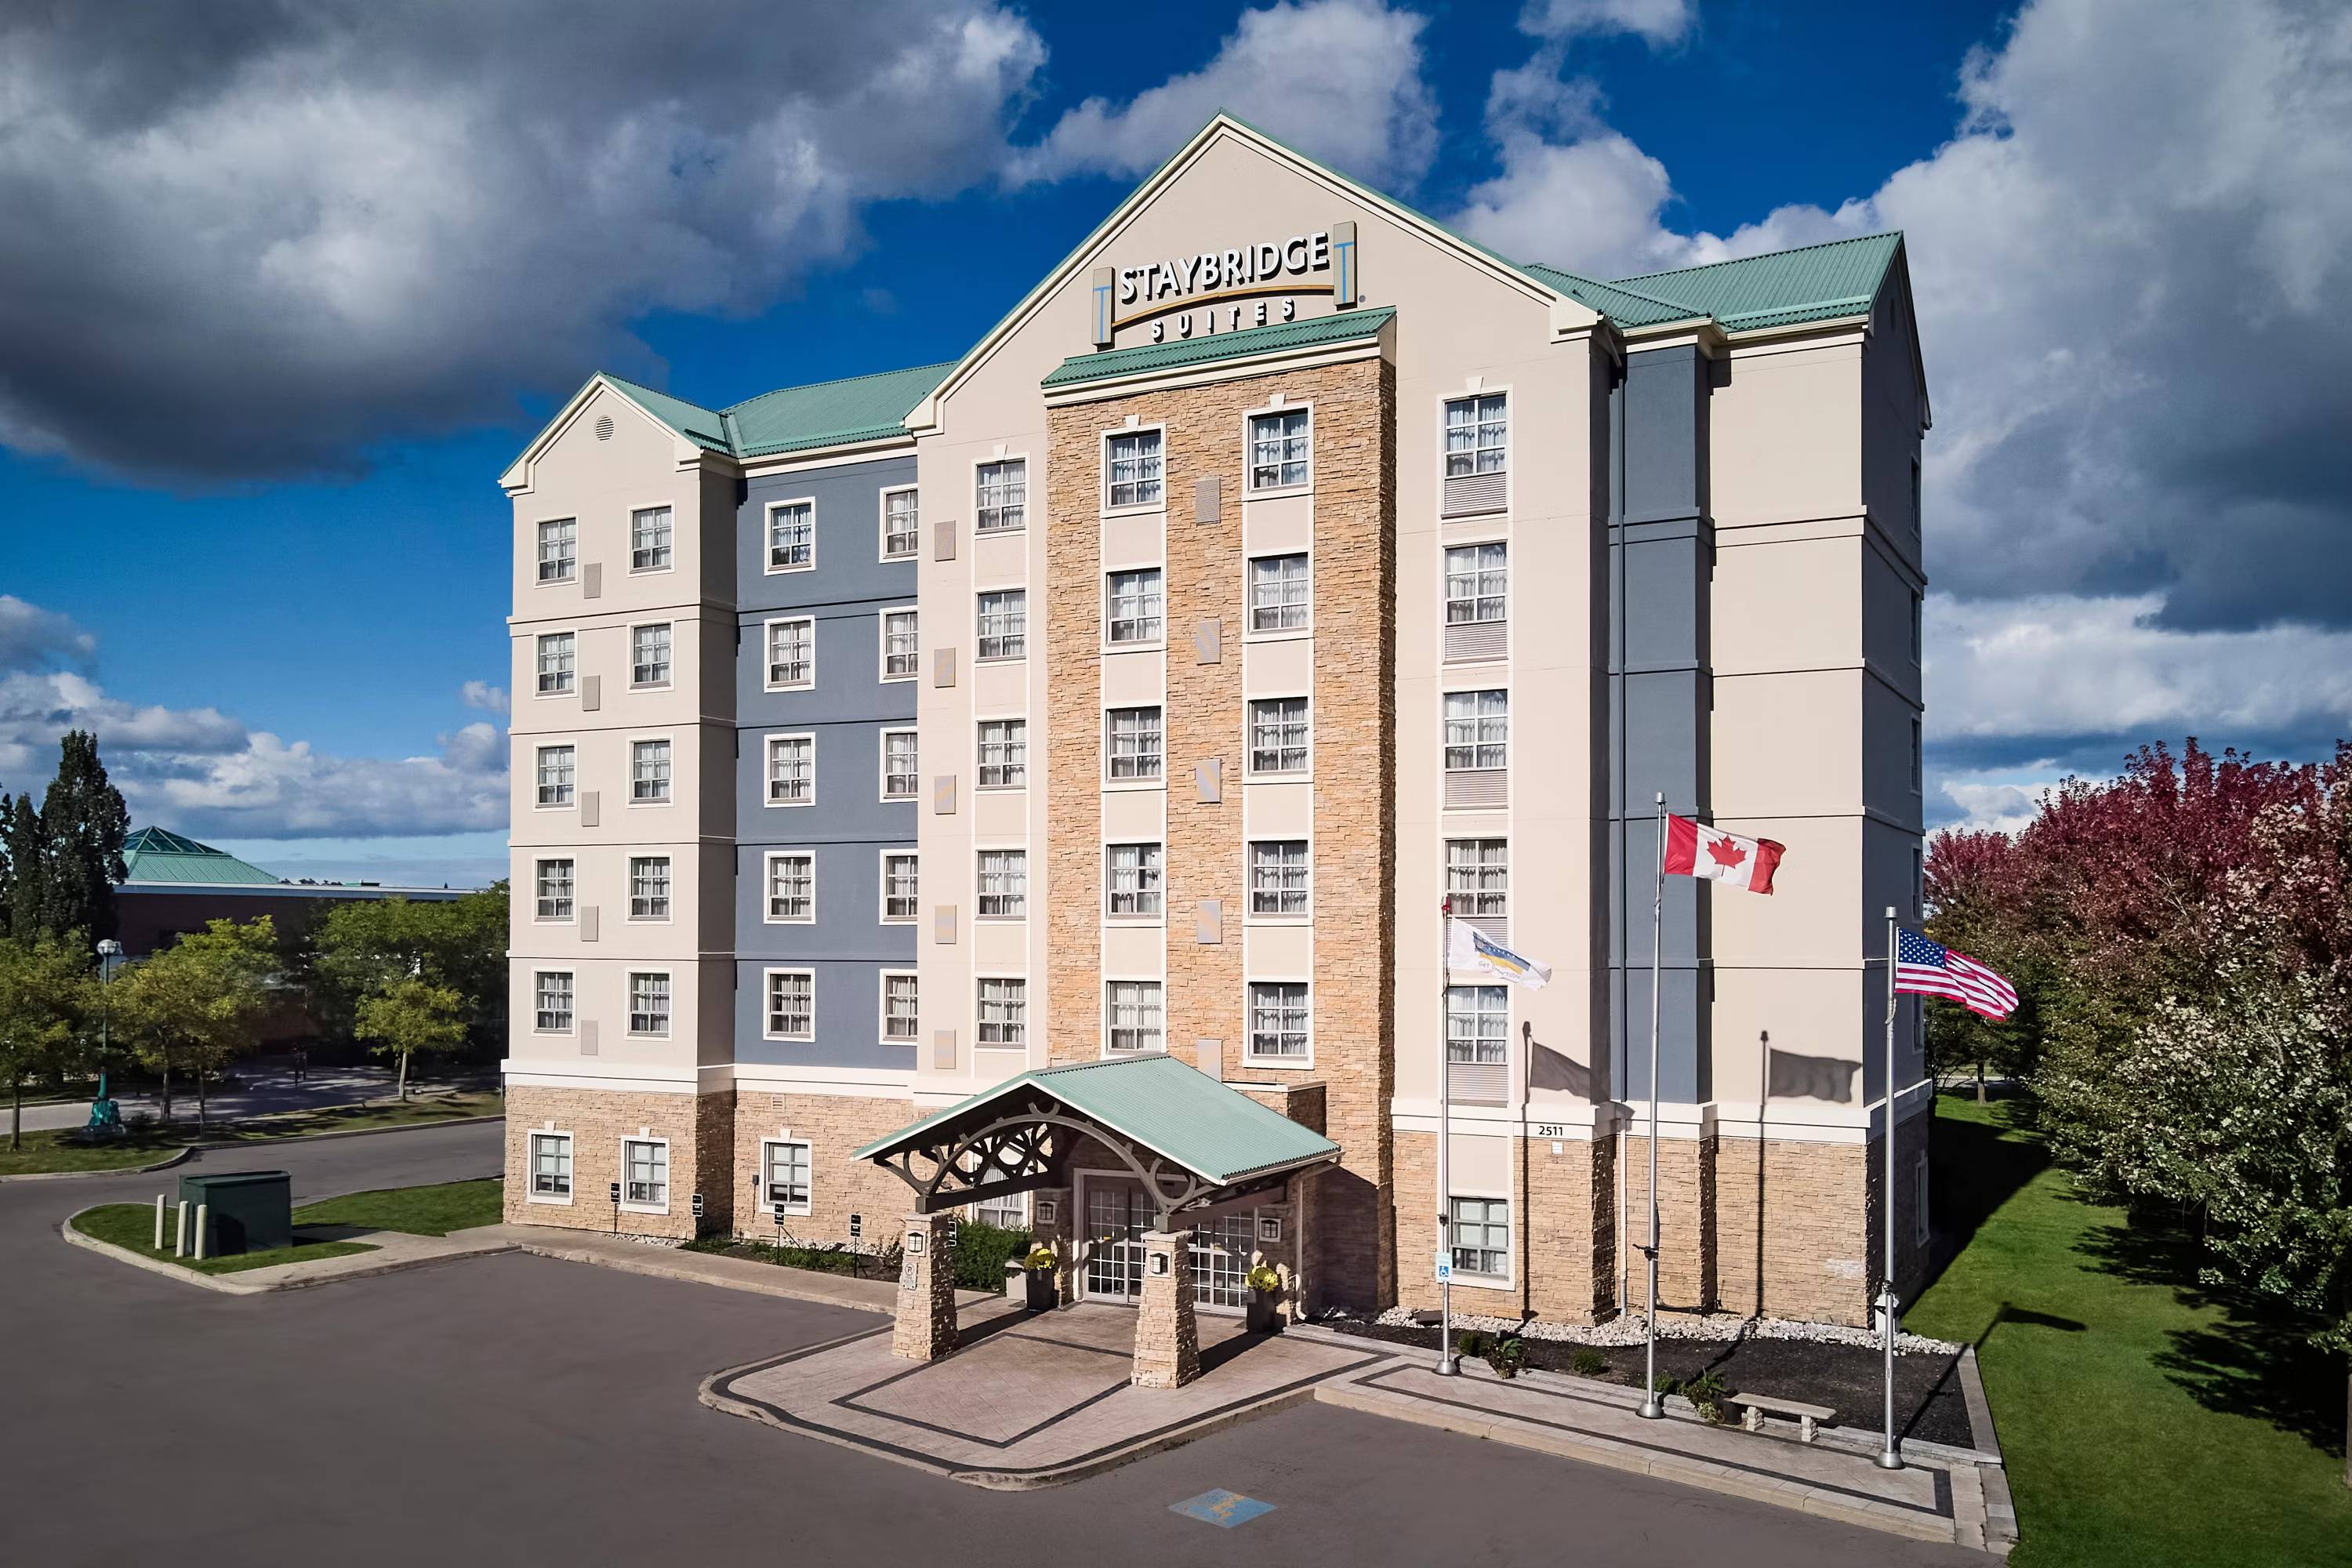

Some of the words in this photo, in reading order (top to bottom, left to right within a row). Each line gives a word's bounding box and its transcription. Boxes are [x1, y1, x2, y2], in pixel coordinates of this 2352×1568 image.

[1120, 232, 1329, 303] STAYBRIDGE
[1151, 298, 1294, 341] SUITES
[1538, 1126, 1563, 1136] 2511
